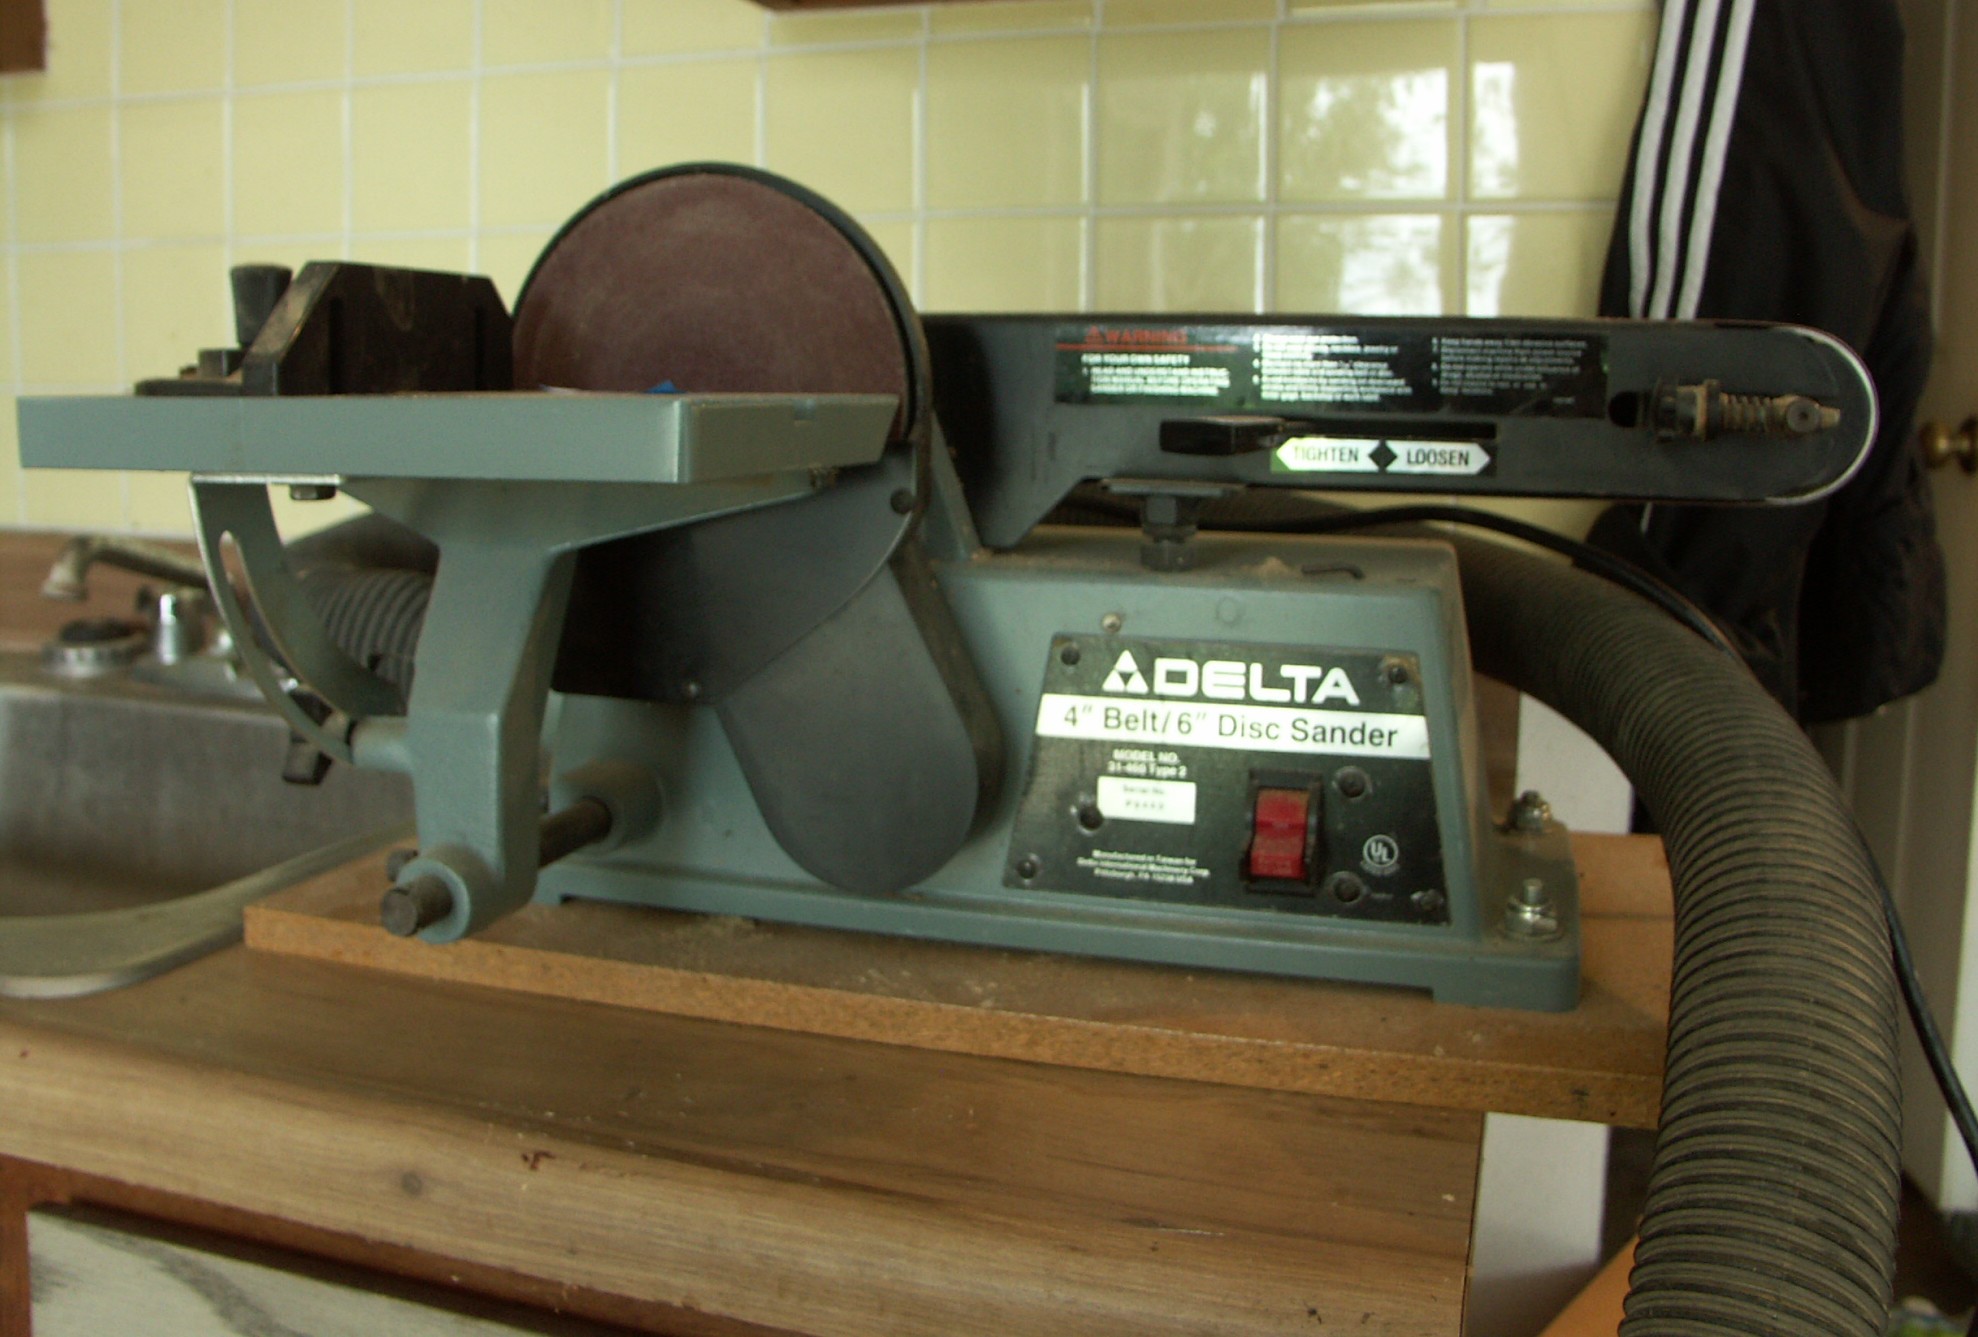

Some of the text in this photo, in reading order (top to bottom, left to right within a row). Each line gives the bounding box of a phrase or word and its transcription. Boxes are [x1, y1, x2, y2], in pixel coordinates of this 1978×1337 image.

[1293, 446, 1470, 466] TIGHTEN LOOSEN
[1153, 657, 1360, 706] DELTA
[1063, 704, 1093, 728] 4"
[1218, 713, 1280, 741] Disc
[1291, 718, 1398, 748] Sander
[1112, 748, 1154, 762] MODEL
